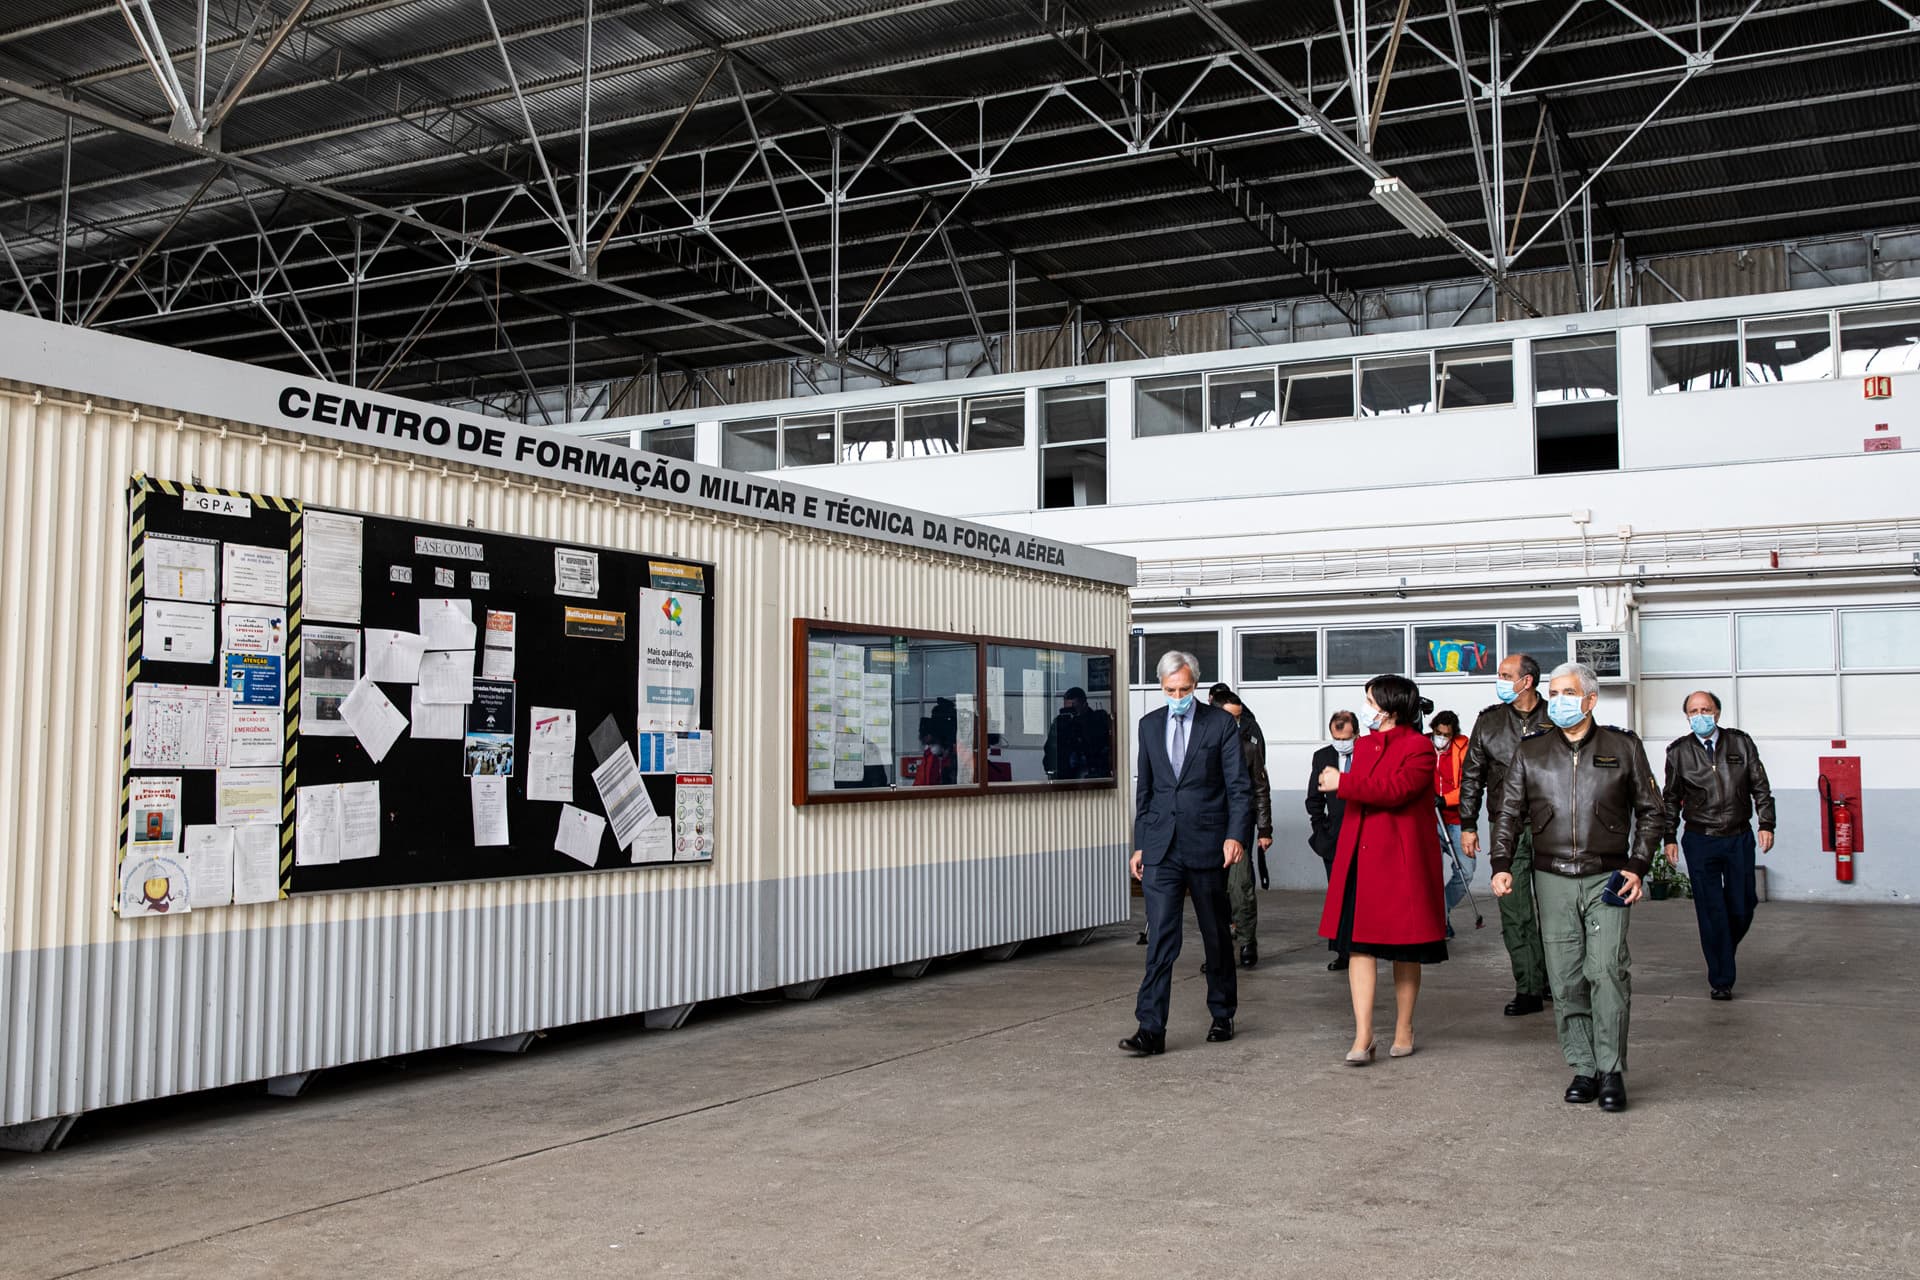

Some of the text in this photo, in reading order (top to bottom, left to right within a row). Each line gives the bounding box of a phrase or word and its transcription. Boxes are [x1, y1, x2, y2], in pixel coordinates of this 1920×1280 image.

[279, 386, 1065, 567] CENTRO DE FORMAÇÃO MILITAR E TÉCNICA DA FORÇA AÉREA
[199, 497, 233, 513] GPA
[416, 540, 483, 559] FASE COMUM
[390, 568, 412, 582] CFO
[435, 570, 454, 585] CFS
[647, 647, 660, 656] Mais
[647, 657, 667, 666] melhor
[234, 725, 270, 733] EMERGÊNCIA
